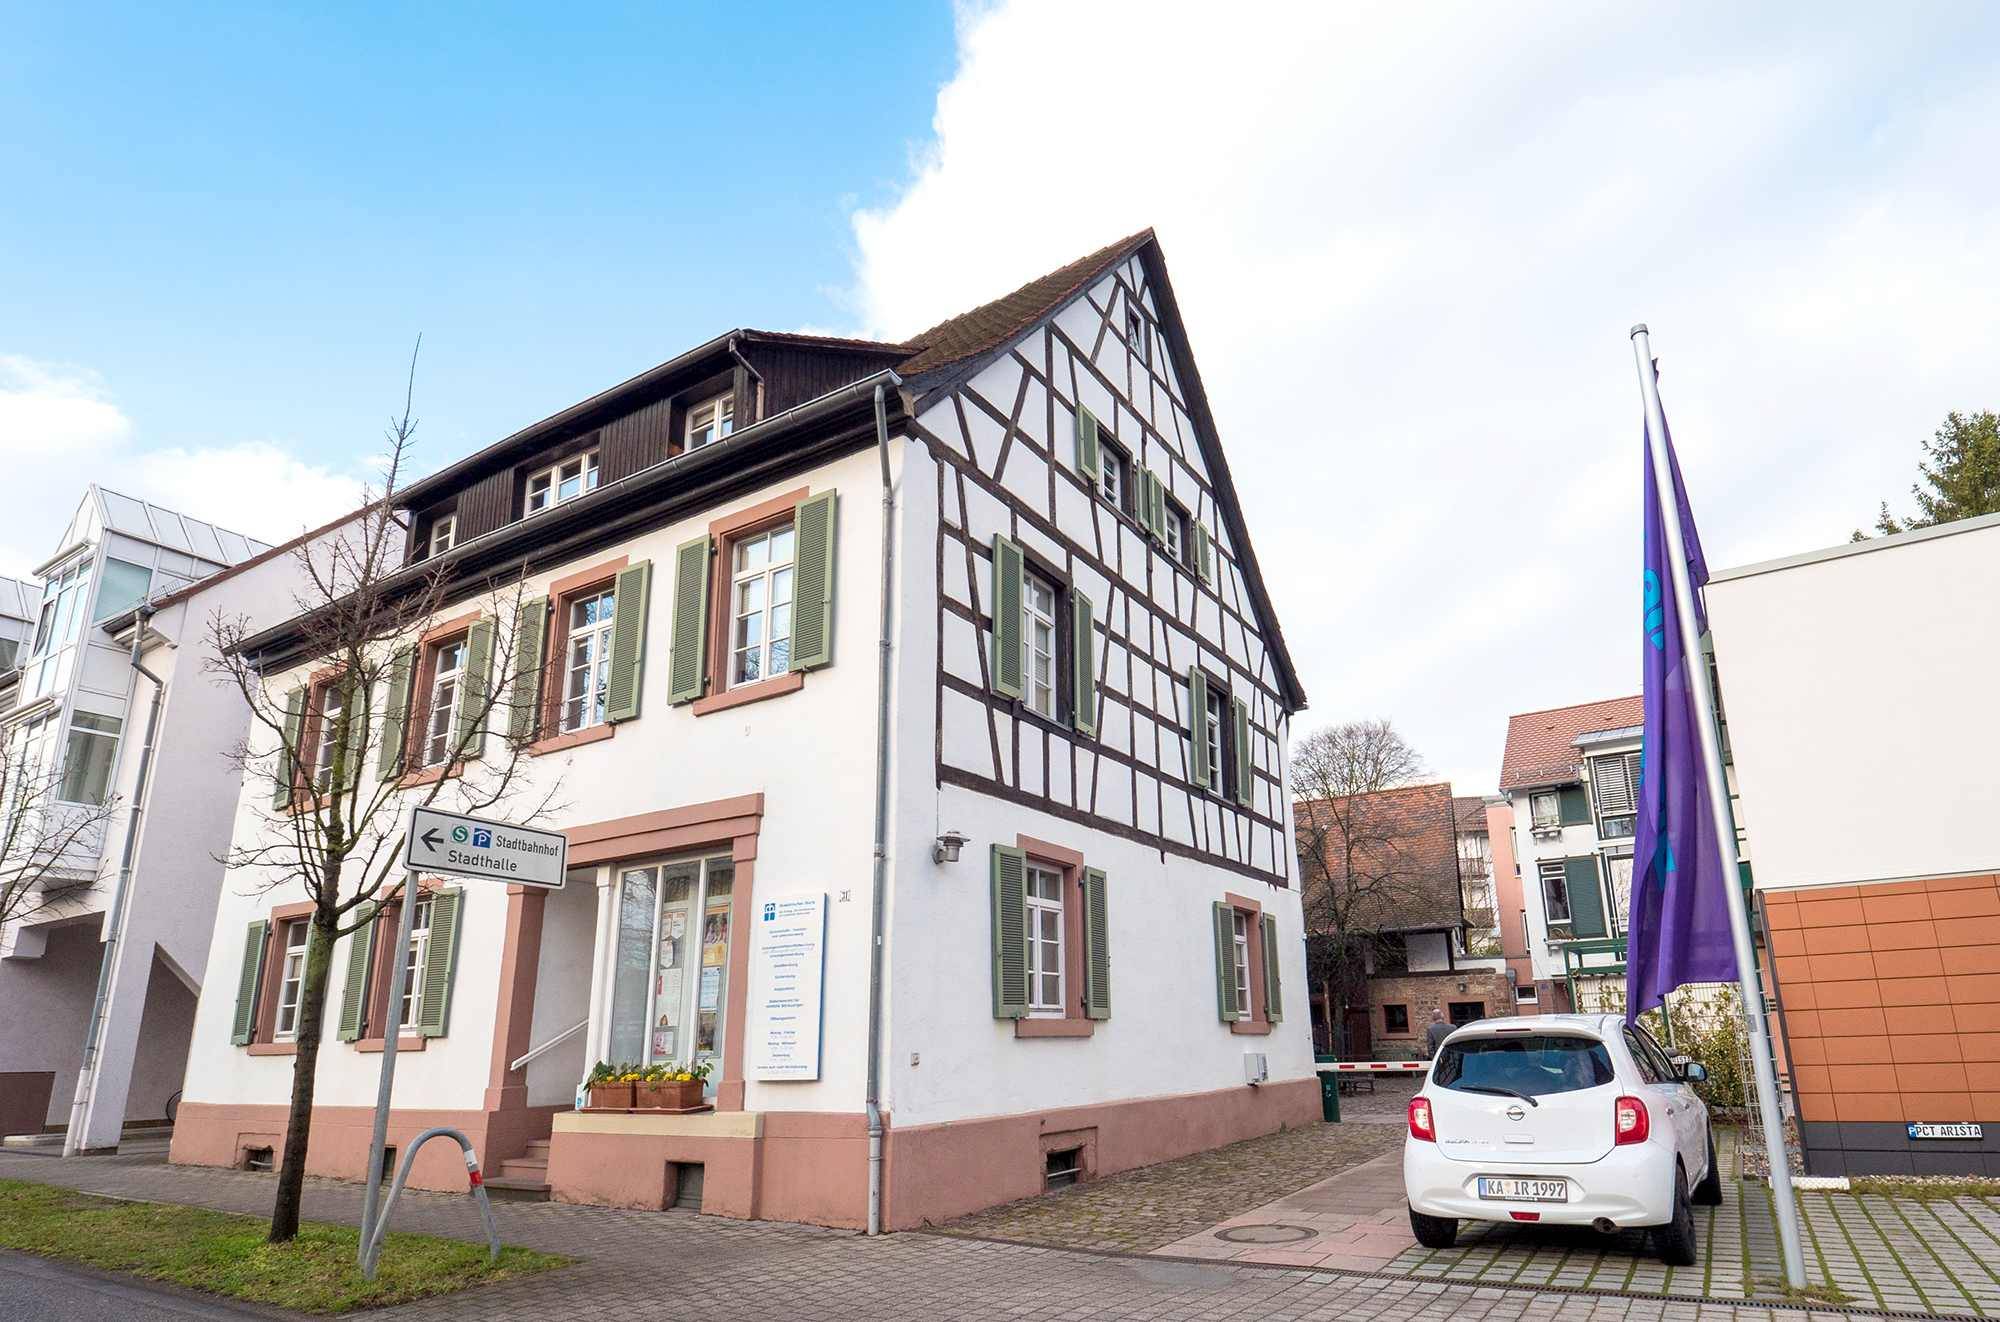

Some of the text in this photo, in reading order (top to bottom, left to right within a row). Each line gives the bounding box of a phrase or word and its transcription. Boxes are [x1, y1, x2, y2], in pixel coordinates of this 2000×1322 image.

[496, 835, 559, 856] Stadtbahnhof
[448, 850, 517, 872] Stadthalle
[1916, 1126, 1935, 1136] PCT
[1940, 1126, 1981, 1136] ARISTA
[1488, 1181, 1564, 1197] KA IR 1997
